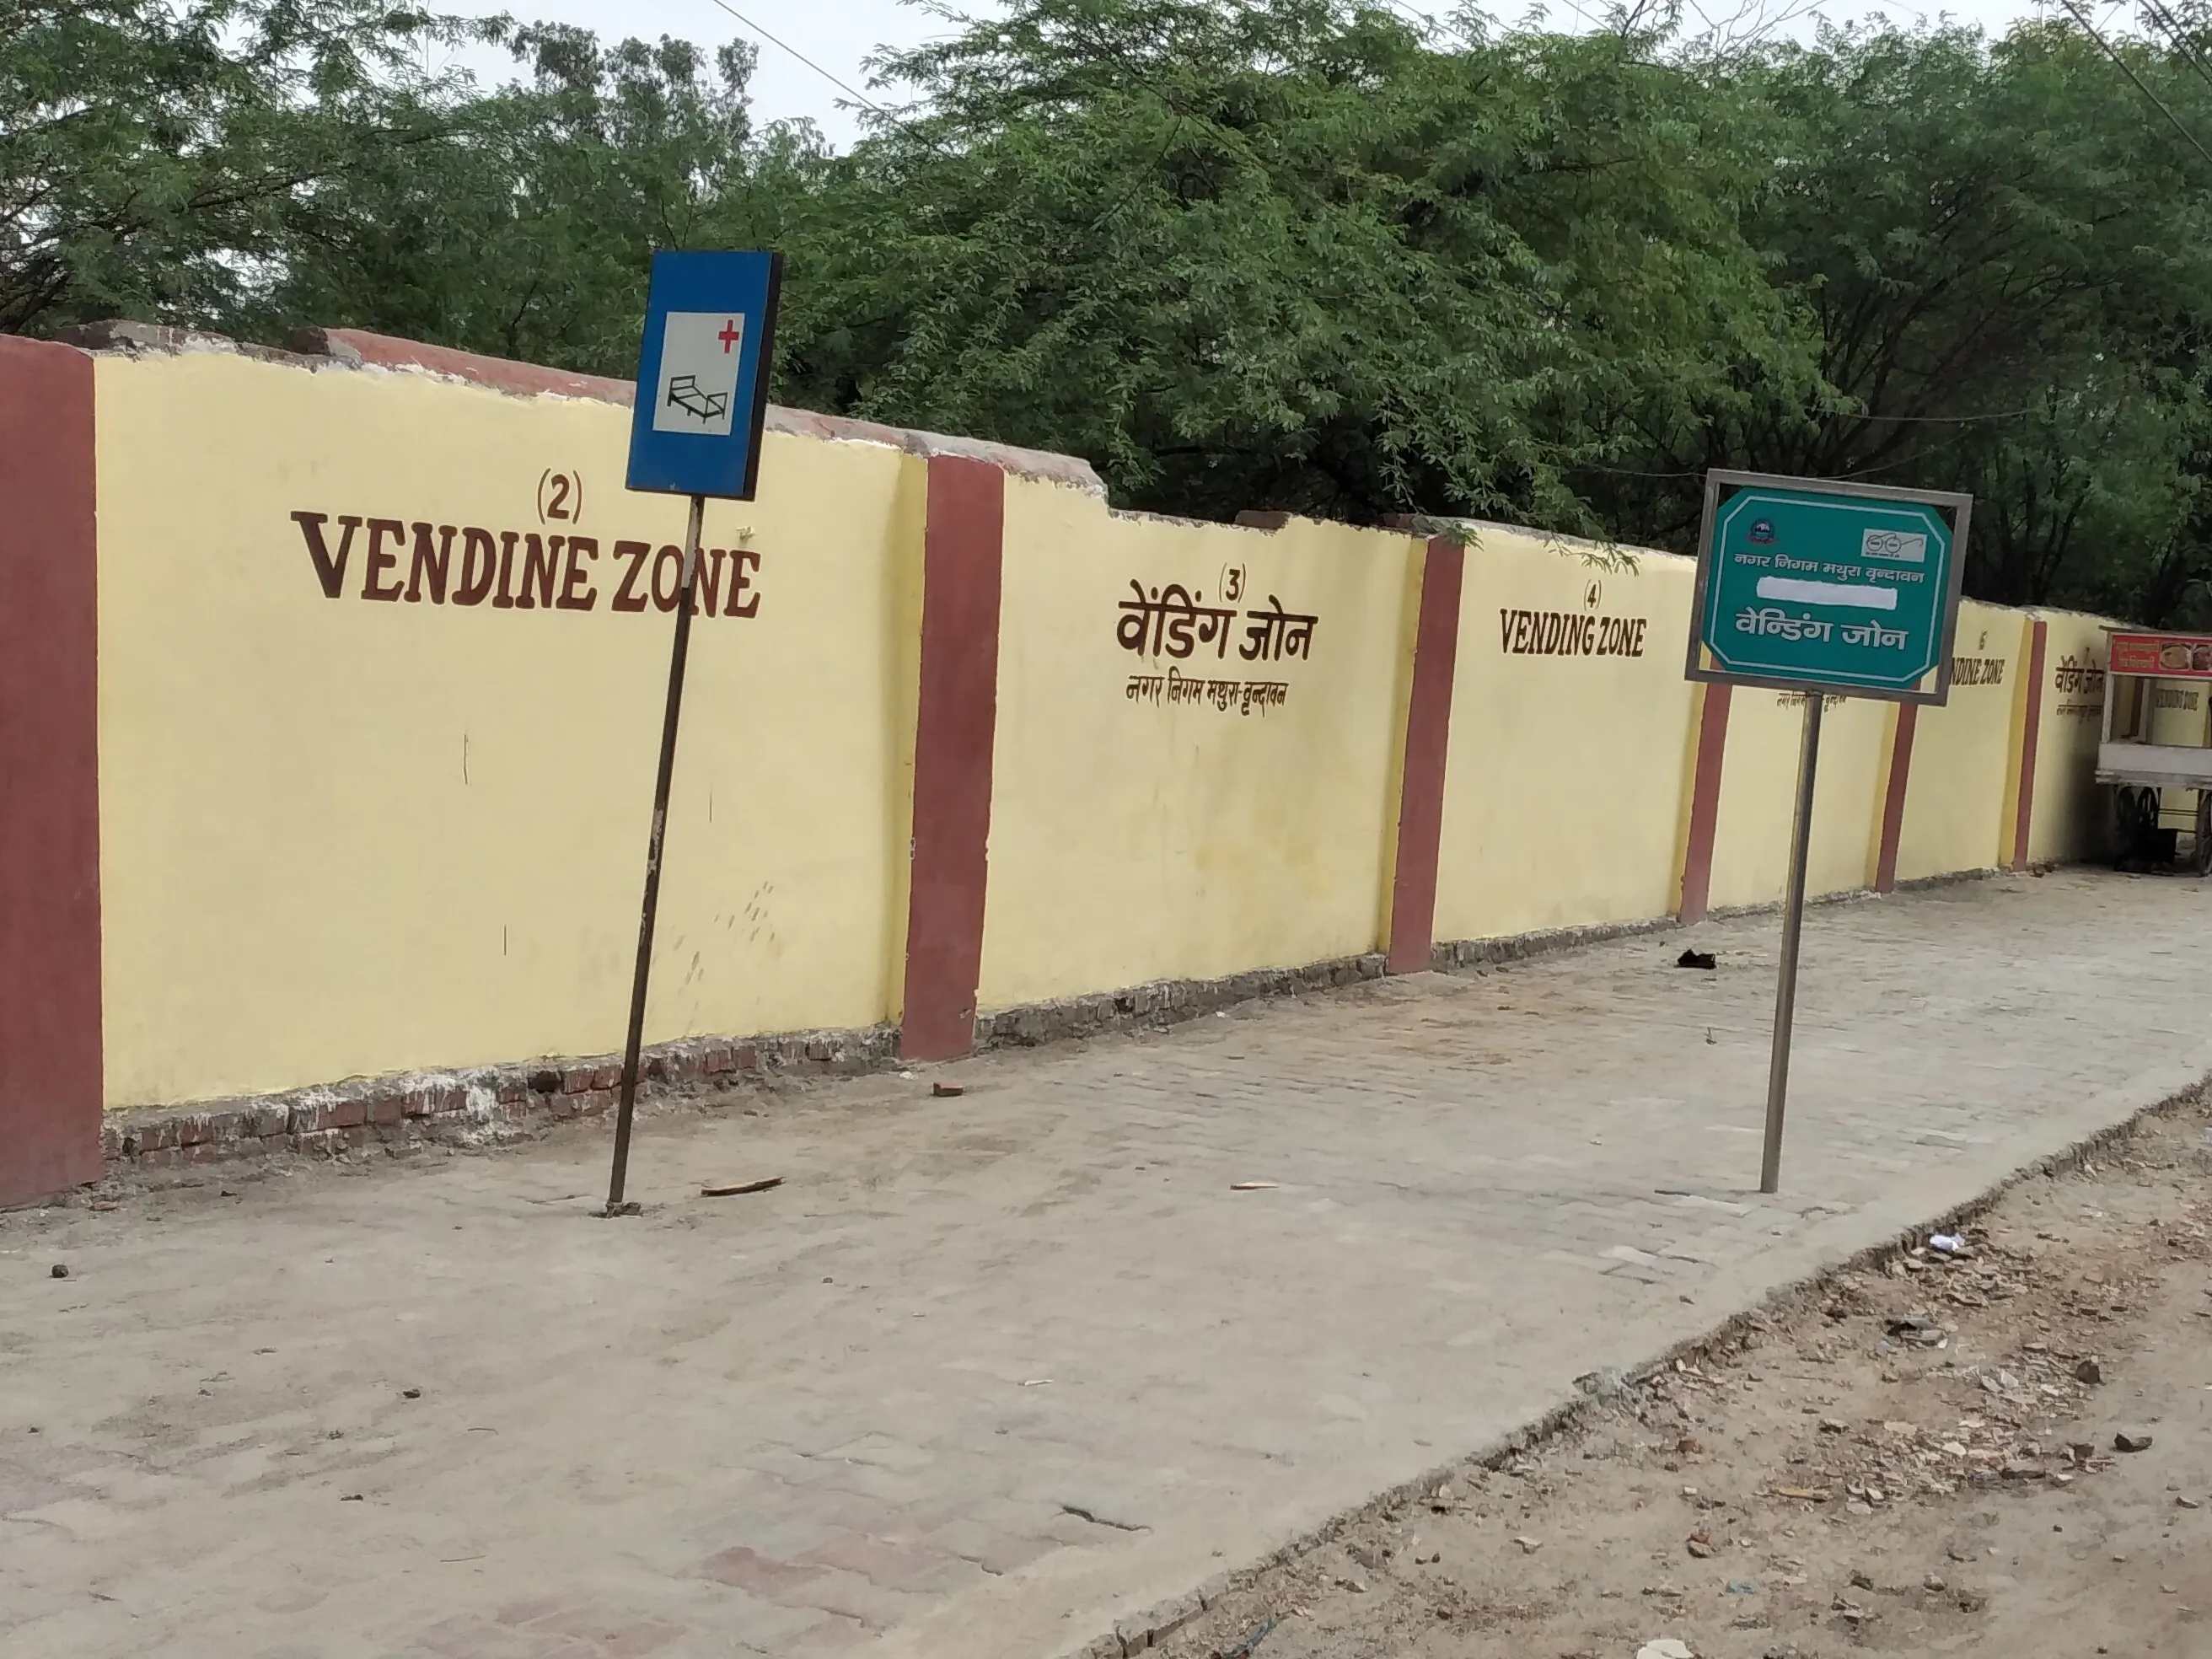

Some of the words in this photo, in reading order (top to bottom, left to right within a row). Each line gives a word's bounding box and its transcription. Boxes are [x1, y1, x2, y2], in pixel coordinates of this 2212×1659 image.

[537, 468, 582, 524] (2)
[291, 511, 599, 611] VENDINE
[611, 540, 760, 618] ZONE
[1734, 553, 1771, 567] नगर
[1774, 553, 1819, 572] निगम
[1823, 562, 1861, 581] मथुरा
[1866, 566, 1925, 583] वृन्दावन
[1584, 578, 1602, 611] (4)
[1117, 578, 1238, 659] वेंडिंग
[1239, 594, 1318, 662] जोन
[1501, 609, 1596, 656] VENDING
[1597, 617, 1647, 657] ZONE
[1735, 606, 1833, 642] वेन्डिंग
[1840, 619, 1909, 651] जोन
[1126, 675, 1165, 708] नगर
[1168, 666, 1205, 705] निगम
